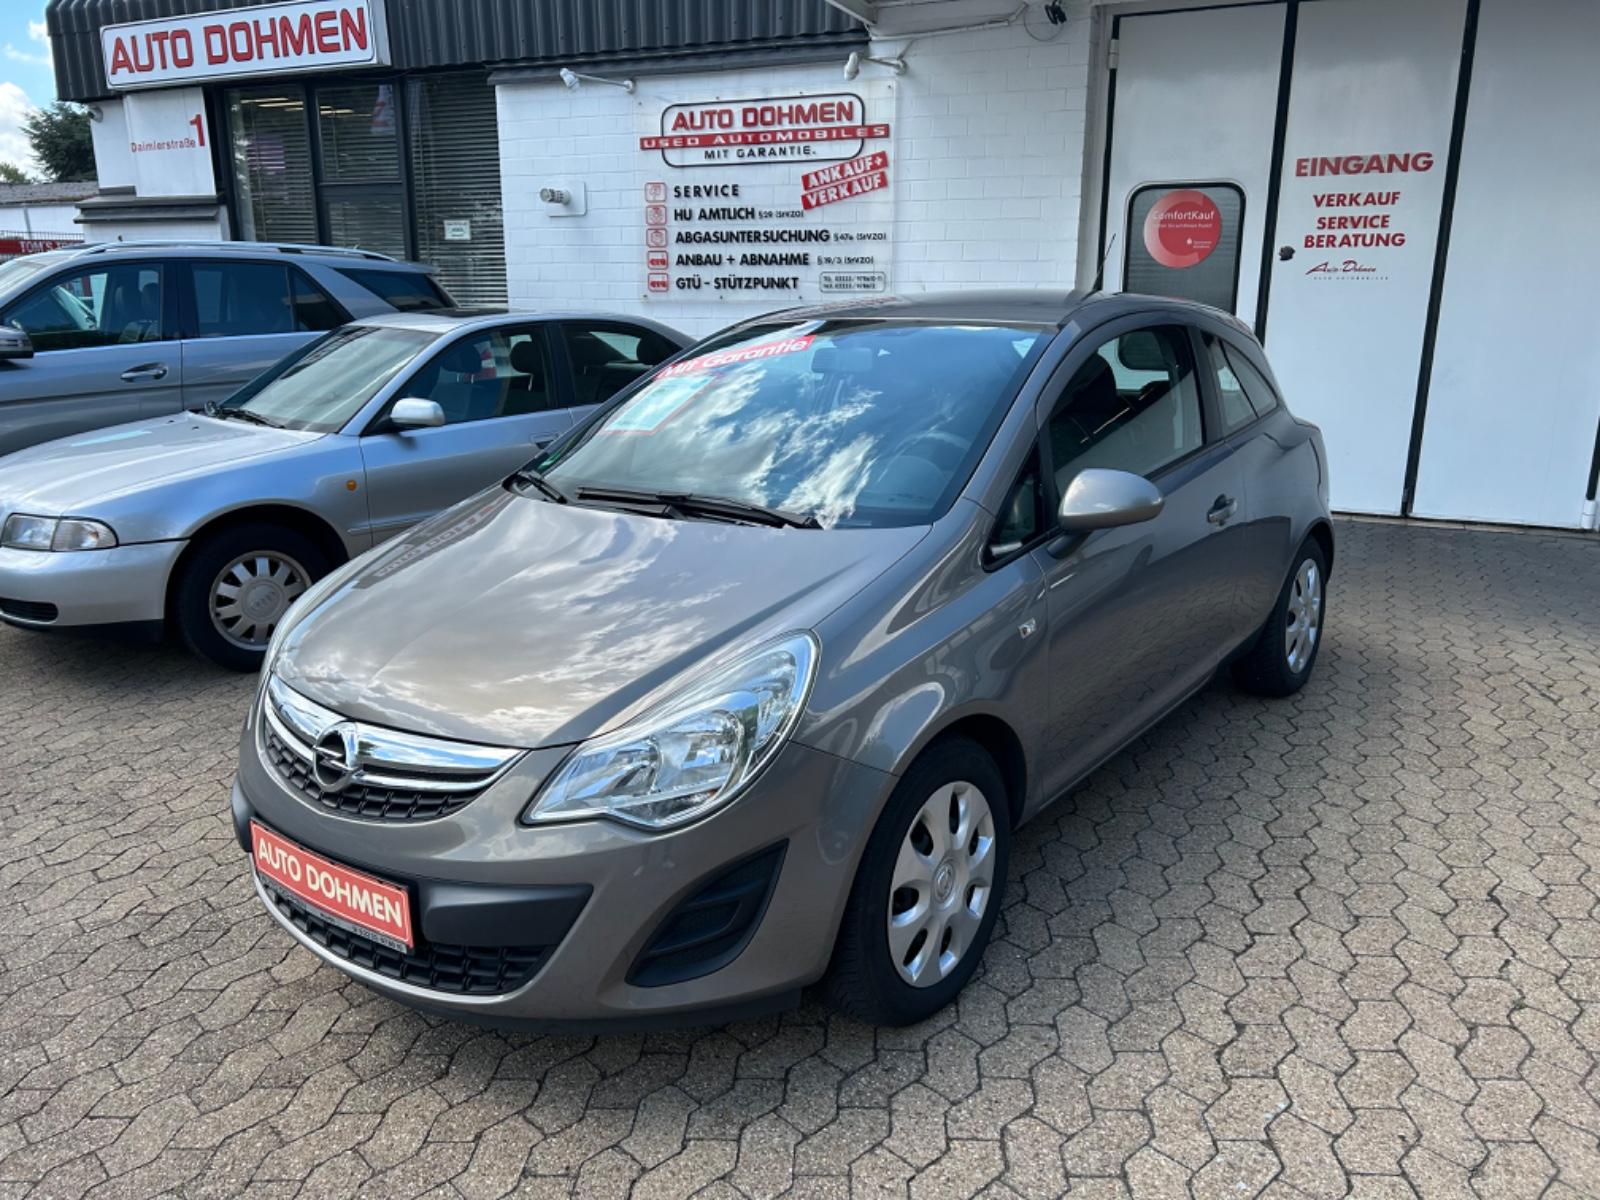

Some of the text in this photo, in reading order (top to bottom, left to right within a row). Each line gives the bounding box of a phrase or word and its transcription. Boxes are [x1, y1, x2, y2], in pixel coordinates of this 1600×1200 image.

[111, 7, 368, 75] AUTO DOHMEN
[671, 101, 854, 131] AUTO DOHMEN
[189, 113, 206, 147] 1
[643, 126, 886, 149] USED AUTOMOBILES
[704, 149, 729, 160] MIT
[1295, 152, 1434, 177] EINGANG
[673, 184, 739, 198] SERVICE
[806, 173, 882, 207] VERKAUF
[1312, 191, 1401, 208] VERKAUF
[674, 208, 693, 221] HU
[698, 207, 755, 221] AMTLICH
[1316, 214, 1391, 230] SERVICE
[675, 229, 830, 244] ABGASUNTERSUCHUNG
[1304, 232, 1406, 249] BERATUNG
[675, 253, 722, 266] ANBAU
[739, 252, 809, 266] ABNAHME
[676, 274, 701, 290] GTÜ
[714, 273, 799, 290] STÜTZPUNKT
[702, 339, 808, 368] Garantie
[258, 838, 301, 882] AUTO
[306, 862, 403, 928] DOHMEN
